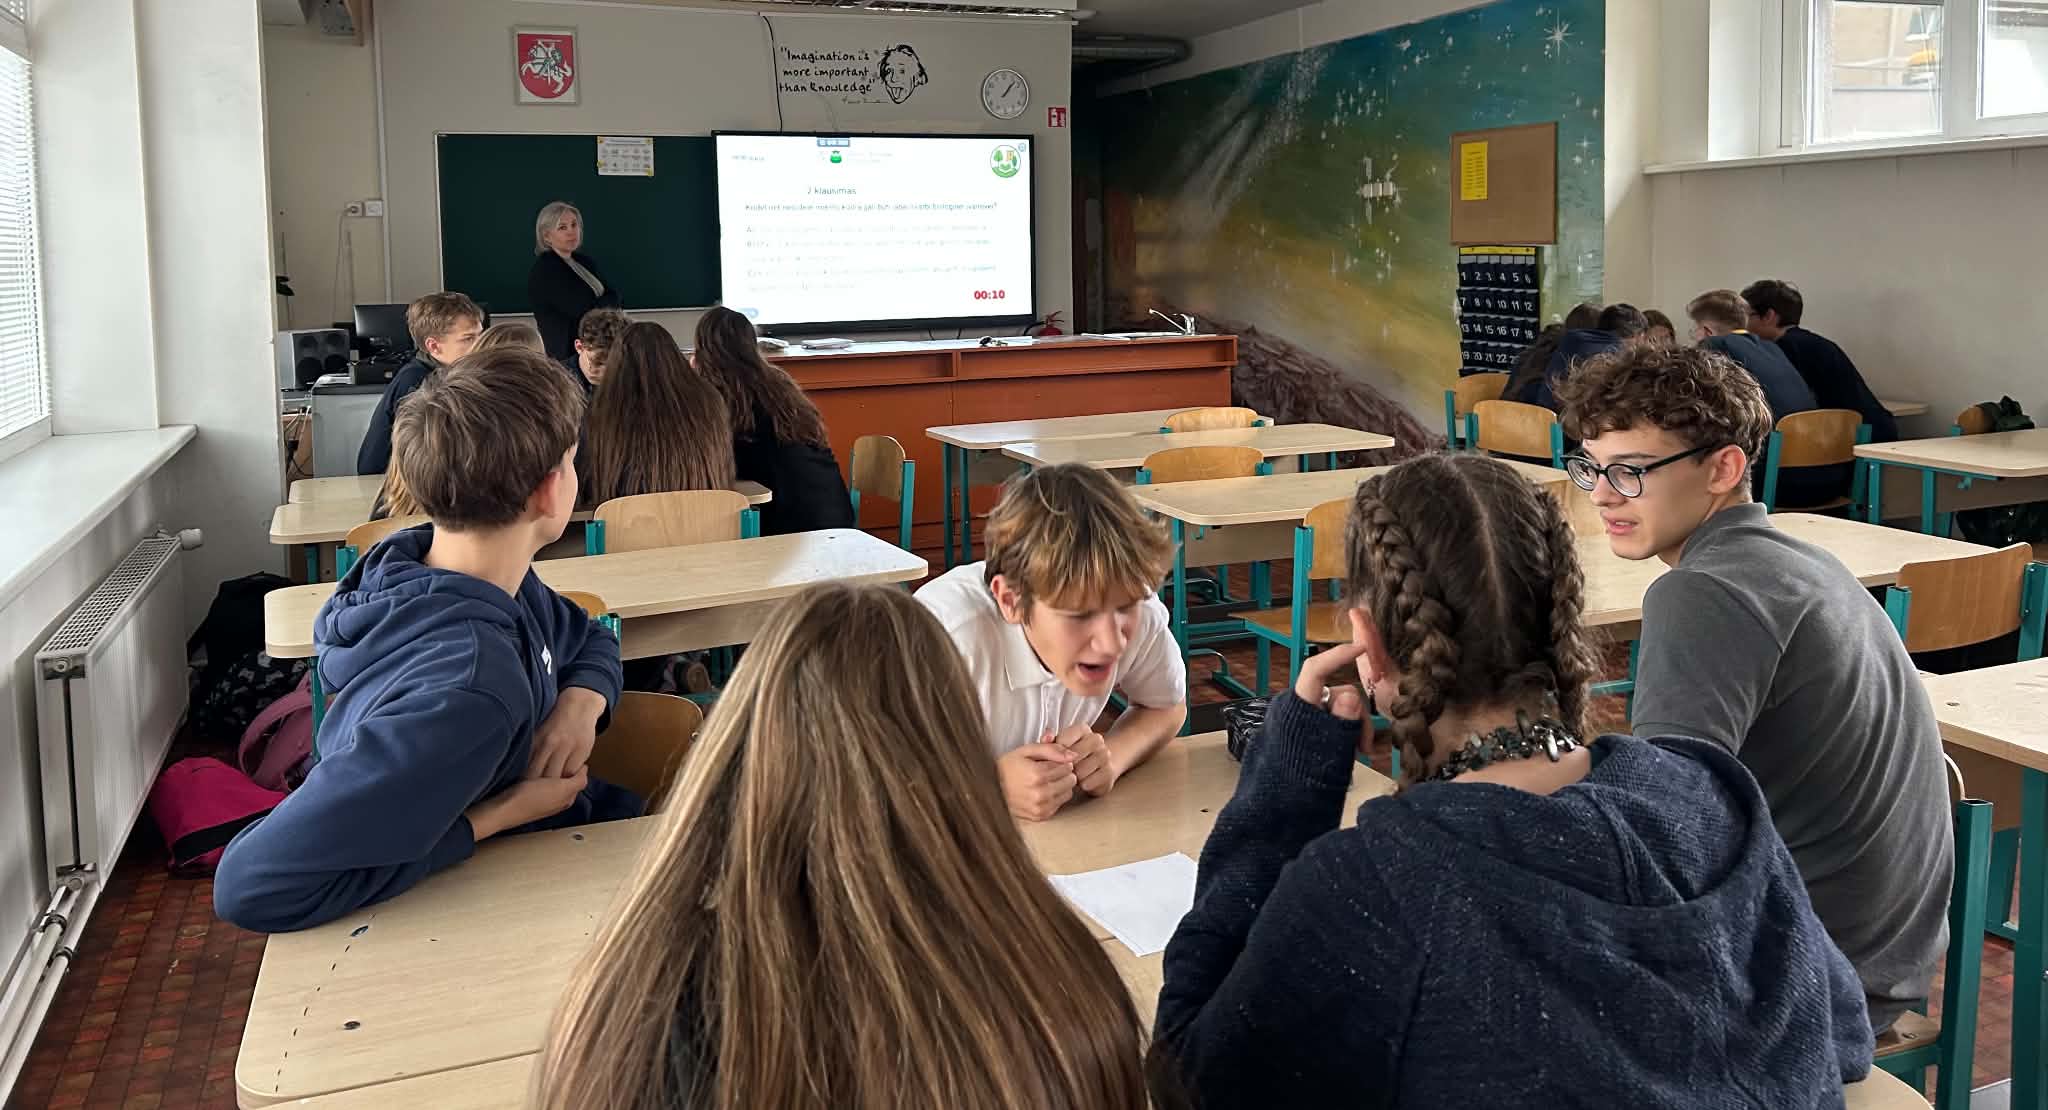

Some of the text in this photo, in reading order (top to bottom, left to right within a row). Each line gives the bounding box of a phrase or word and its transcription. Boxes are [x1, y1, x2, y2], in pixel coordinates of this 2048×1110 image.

[858, 50, 870, 61] is
[783, 66, 870, 79] more important
[779, 81, 807, 93] than
[814, 185, 857, 195] klausimas
[1461, 271, 1466, 281] 1
[1474, 271, 1481, 281] 2
[1486, 272, 1492, 281] 3
[1500, 272, 1506, 282] 4
[1512, 272, 1519, 282] 5
[973, 289, 1006, 300] 00:10
[1460, 297, 1533, 311] 7 8 9 10 11 12
[1461, 323, 1534, 340] 13 14 15 16 17 18
[1473, 351, 1482, 361] 20
[1484, 353, 1493, 362] 21
[1496, 353, 1507, 363] 22
